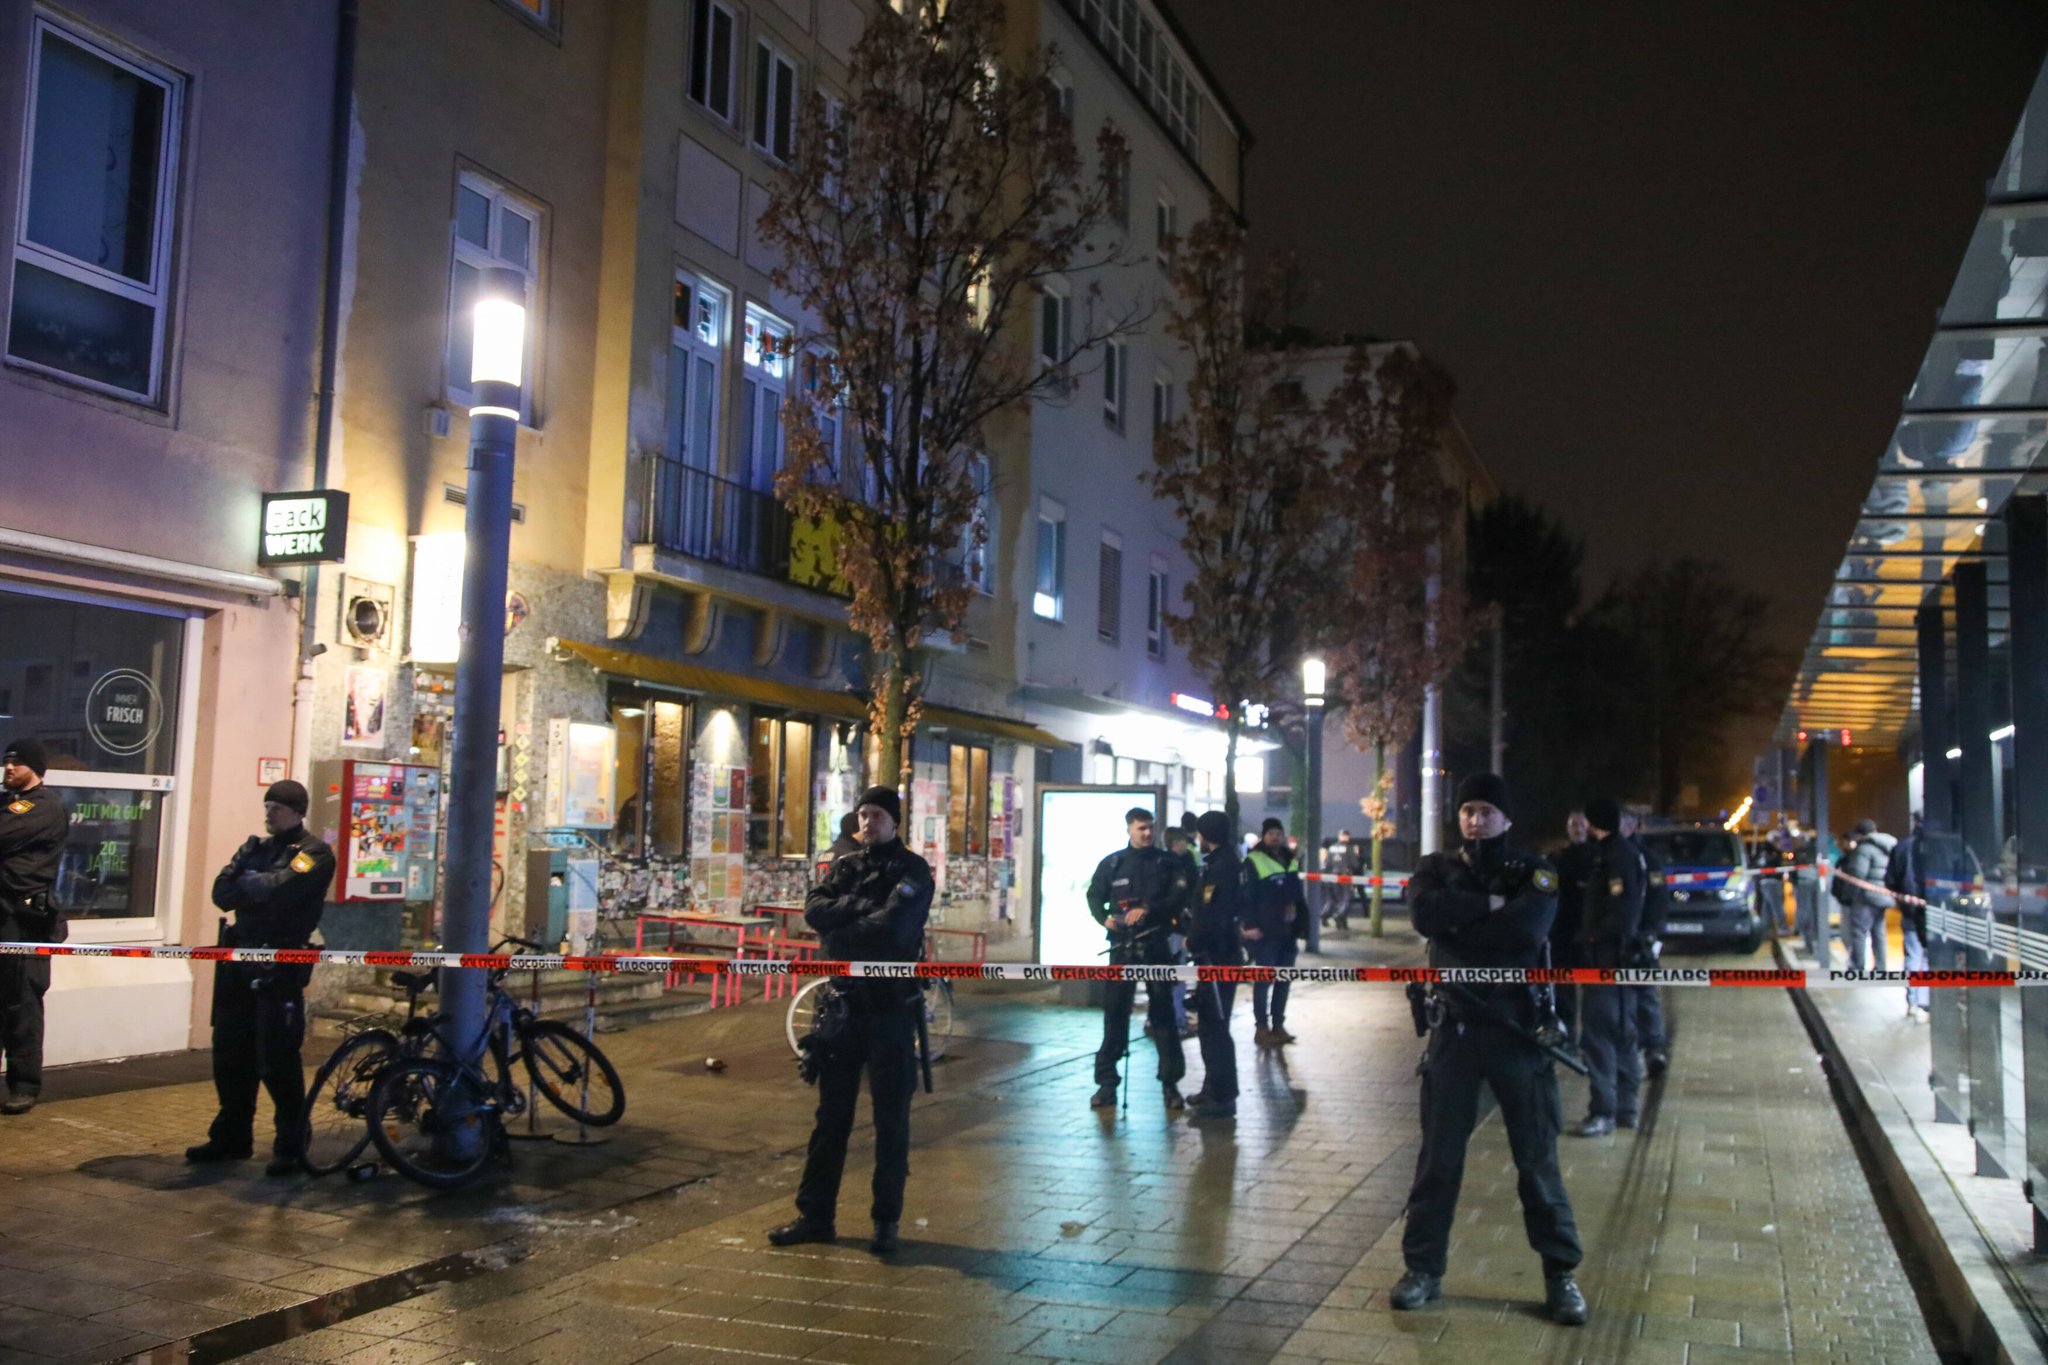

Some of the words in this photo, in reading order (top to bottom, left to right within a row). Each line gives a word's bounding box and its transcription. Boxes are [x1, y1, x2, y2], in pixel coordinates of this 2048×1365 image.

[265, 532, 325, 557] WERK
[106, 706, 144, 725] FRISCH
[101, 804, 121, 820] MIR
[100, 840, 117, 856] 20
[86, 854, 127, 873] JAHRE
